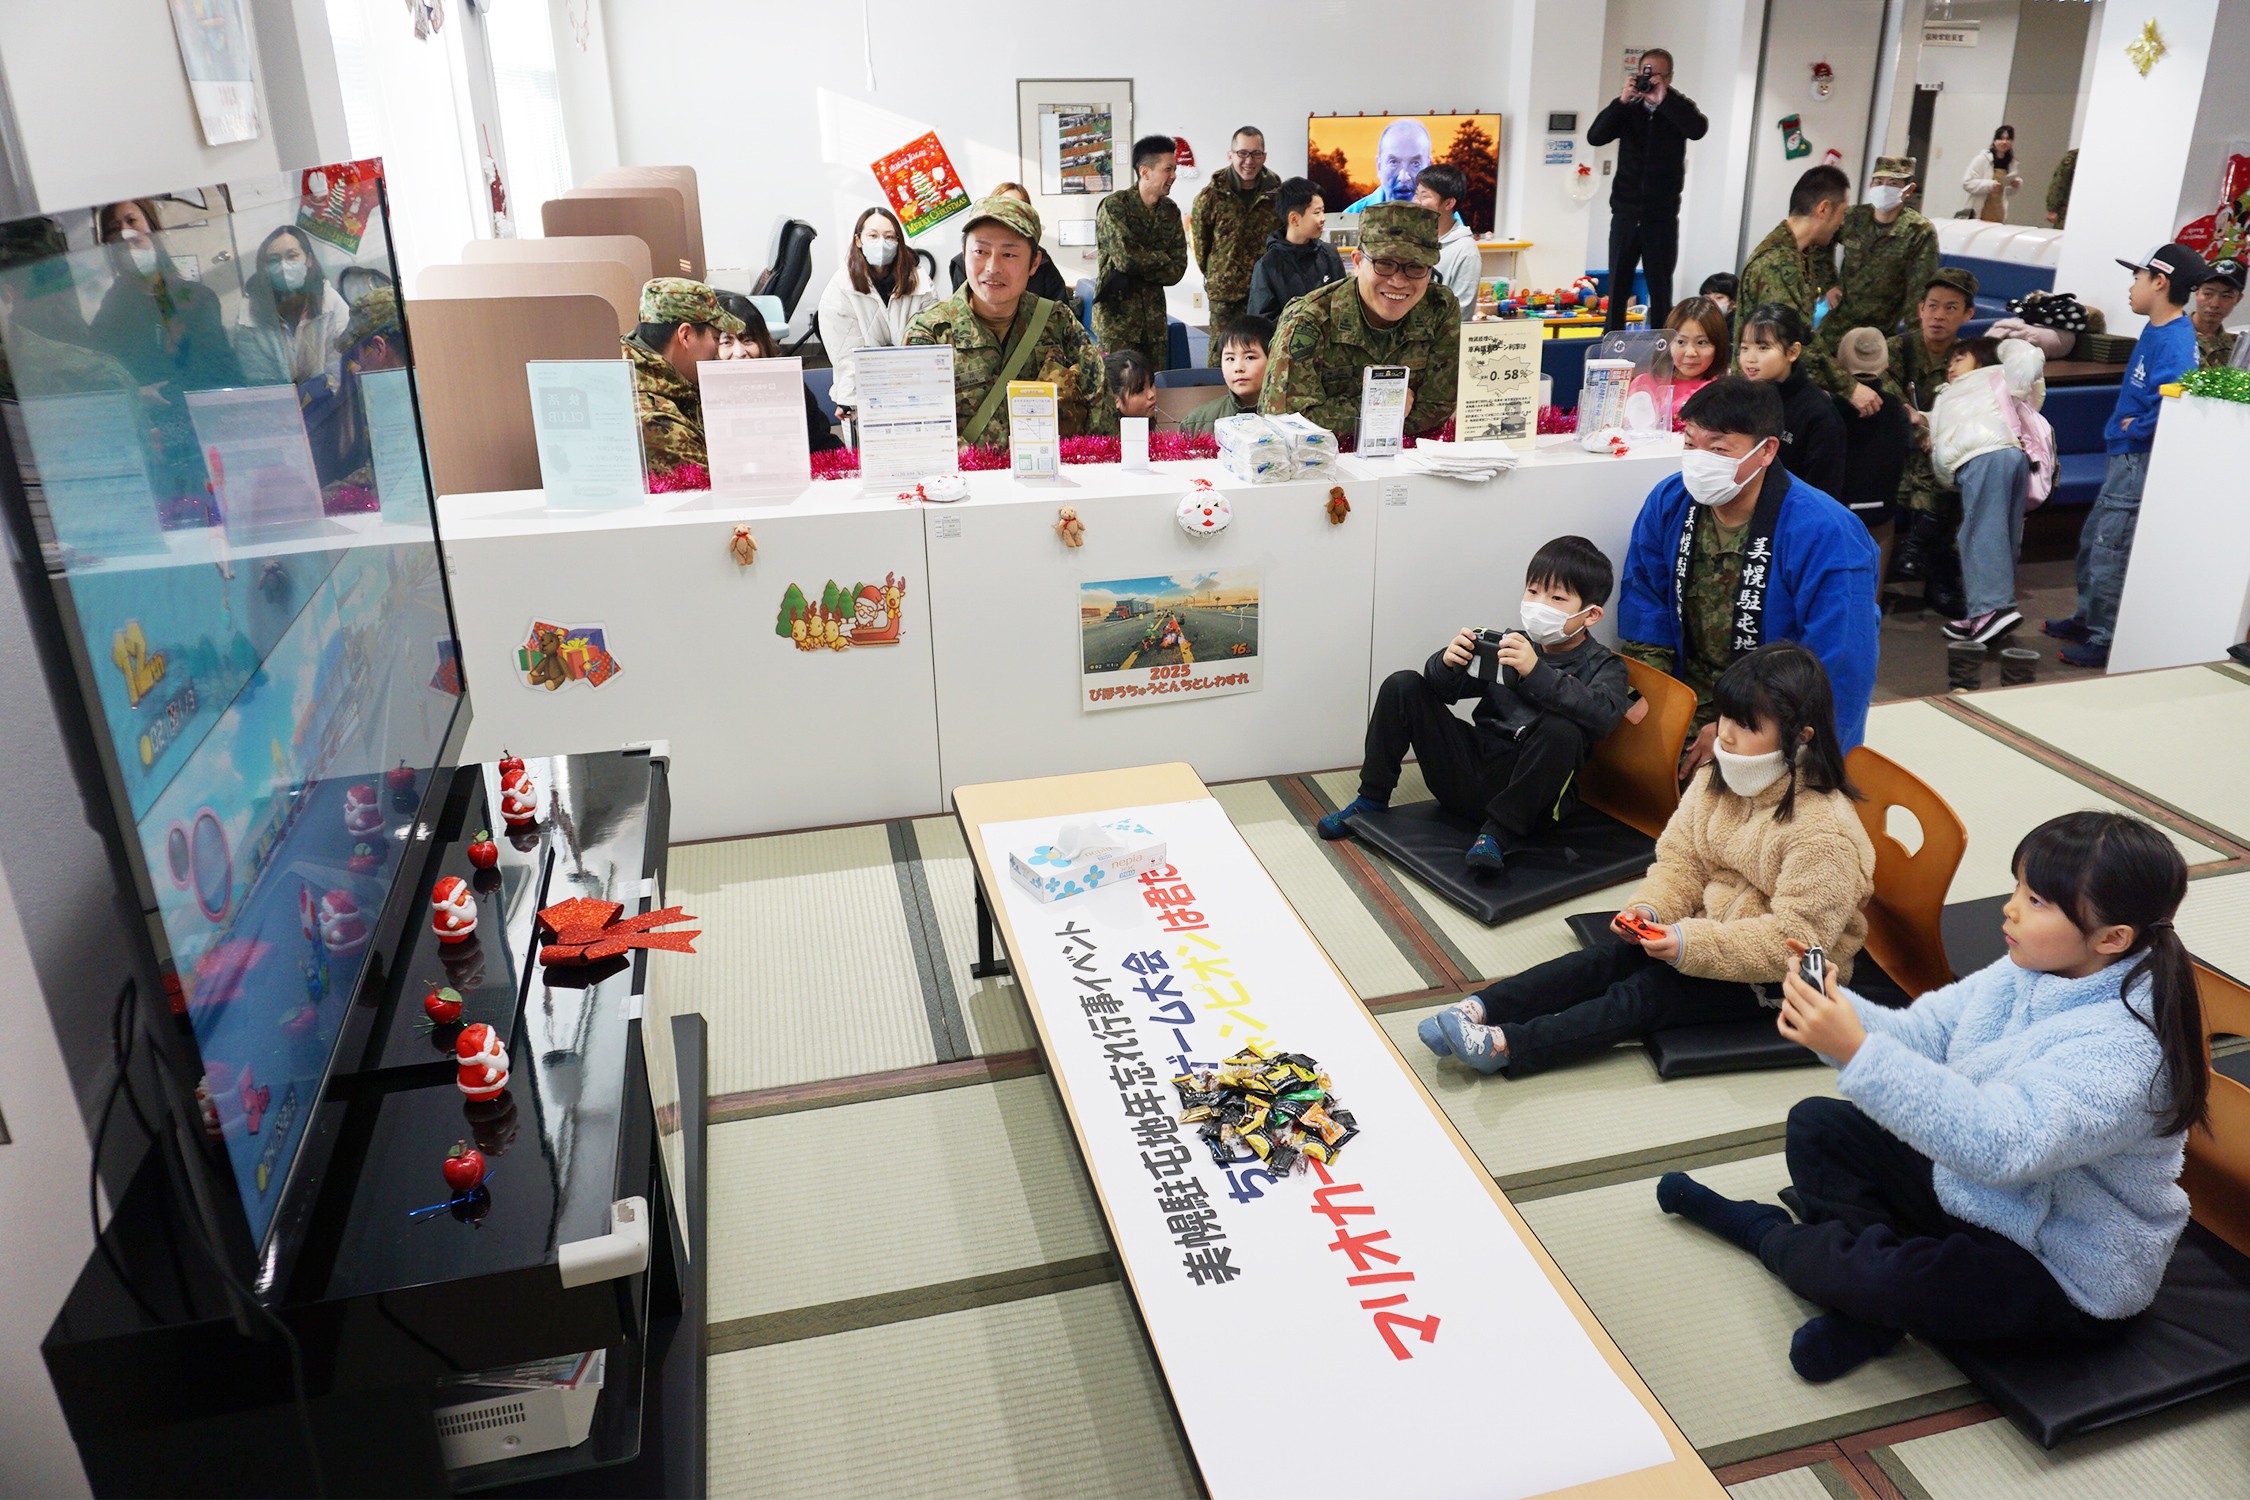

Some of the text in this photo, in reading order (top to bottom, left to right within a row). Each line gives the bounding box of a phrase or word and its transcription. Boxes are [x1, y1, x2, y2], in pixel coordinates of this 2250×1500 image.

[1734, 537, 1771, 650] 美幌駐屯地
[1150, 664, 1191, 681] 2025
[1111, 853, 1143, 869] nepia
[1055, 920, 1241, 1286] 美幌駐屯地年忘れ行事イベント
